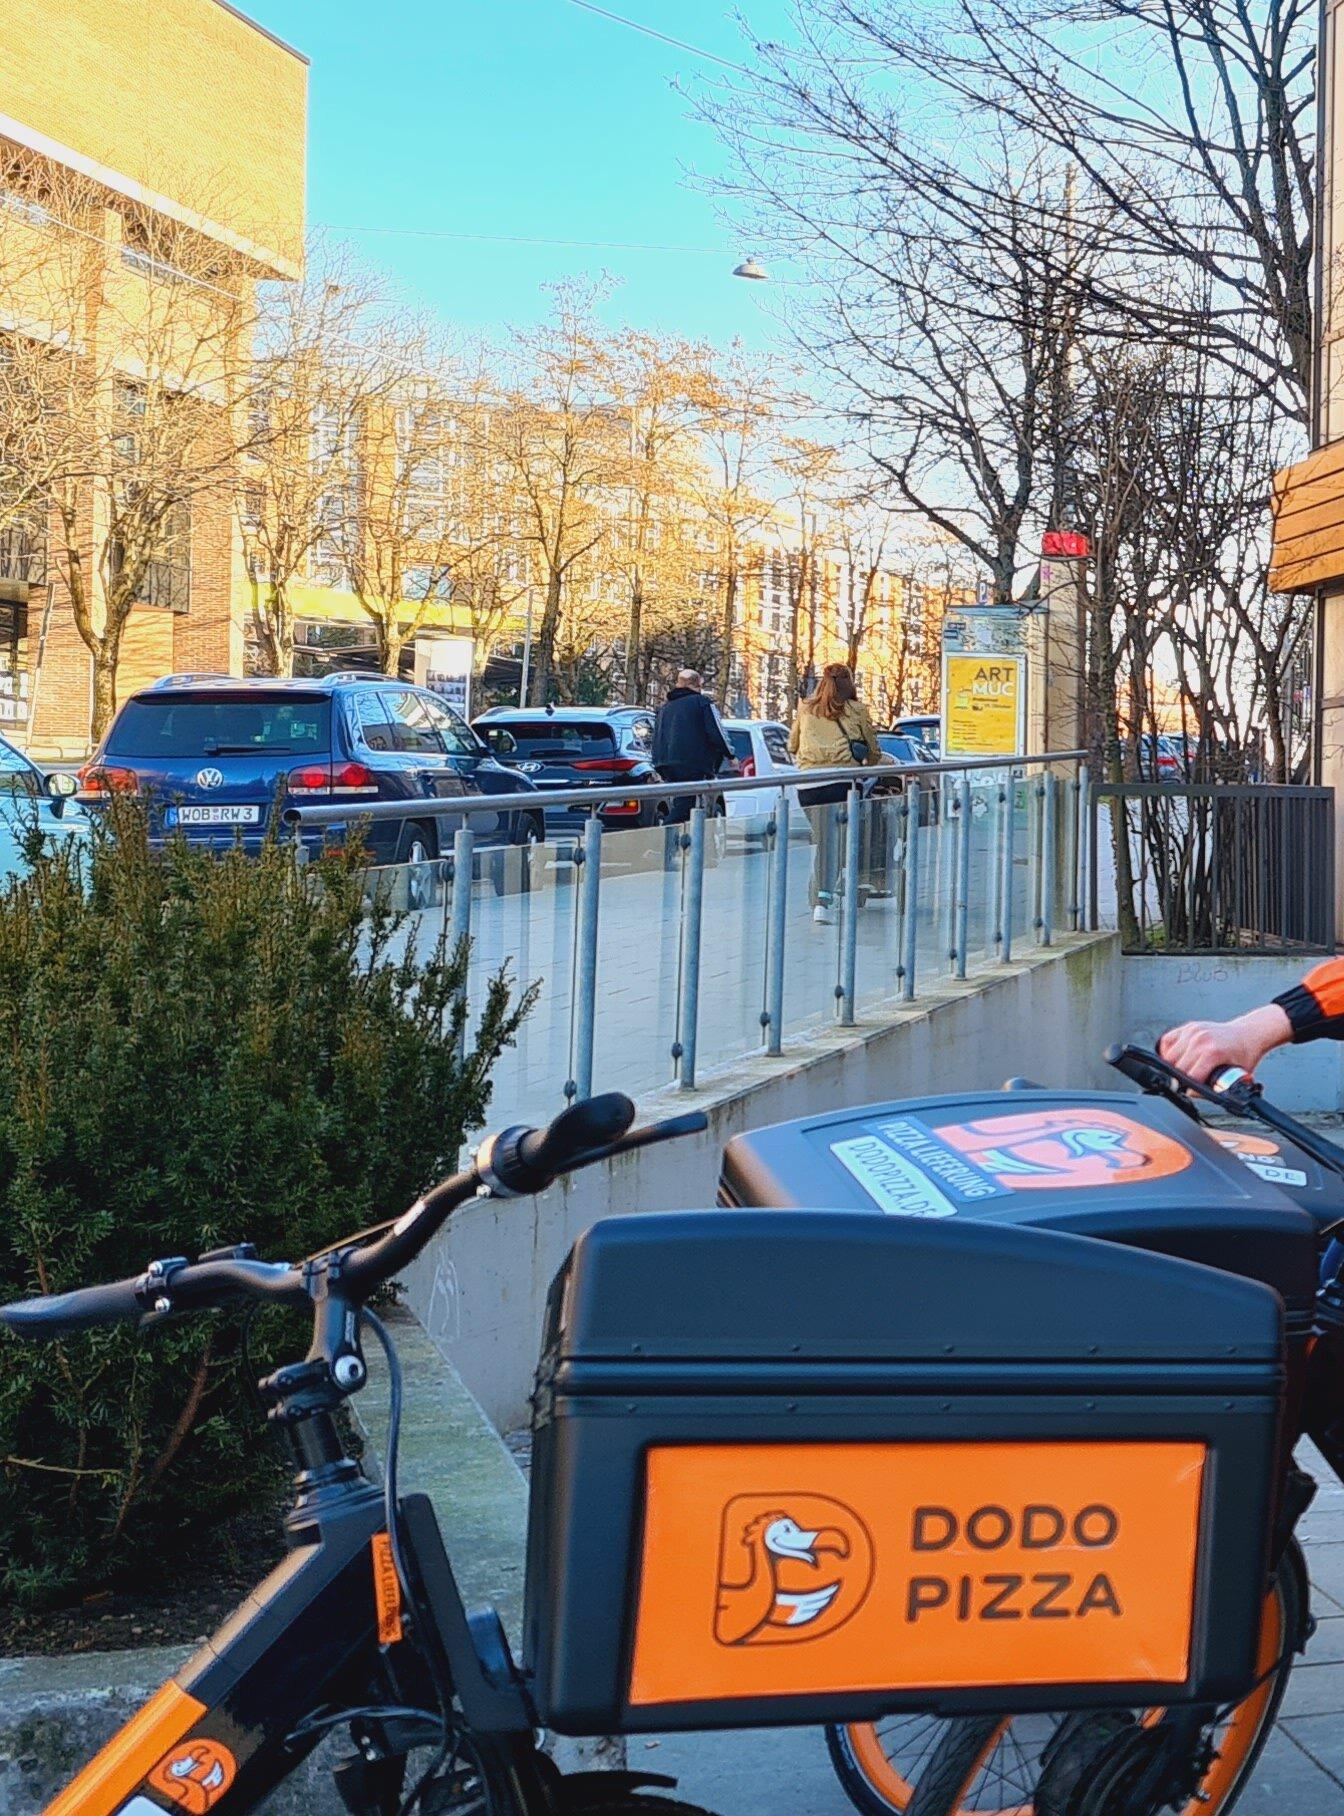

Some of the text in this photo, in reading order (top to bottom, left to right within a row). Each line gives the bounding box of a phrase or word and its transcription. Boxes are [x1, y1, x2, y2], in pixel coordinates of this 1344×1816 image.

[972, 682, 1015, 697] MUC
[974, 667, 1014, 681] ART
[182, 808, 253, 821] WOB RW 3
[877, 1121, 997, 1198] PIZZA LIEFERUNG
[912, 1504, 1121, 1552] DODO
[907, 1574, 1122, 1623] PIZZA
